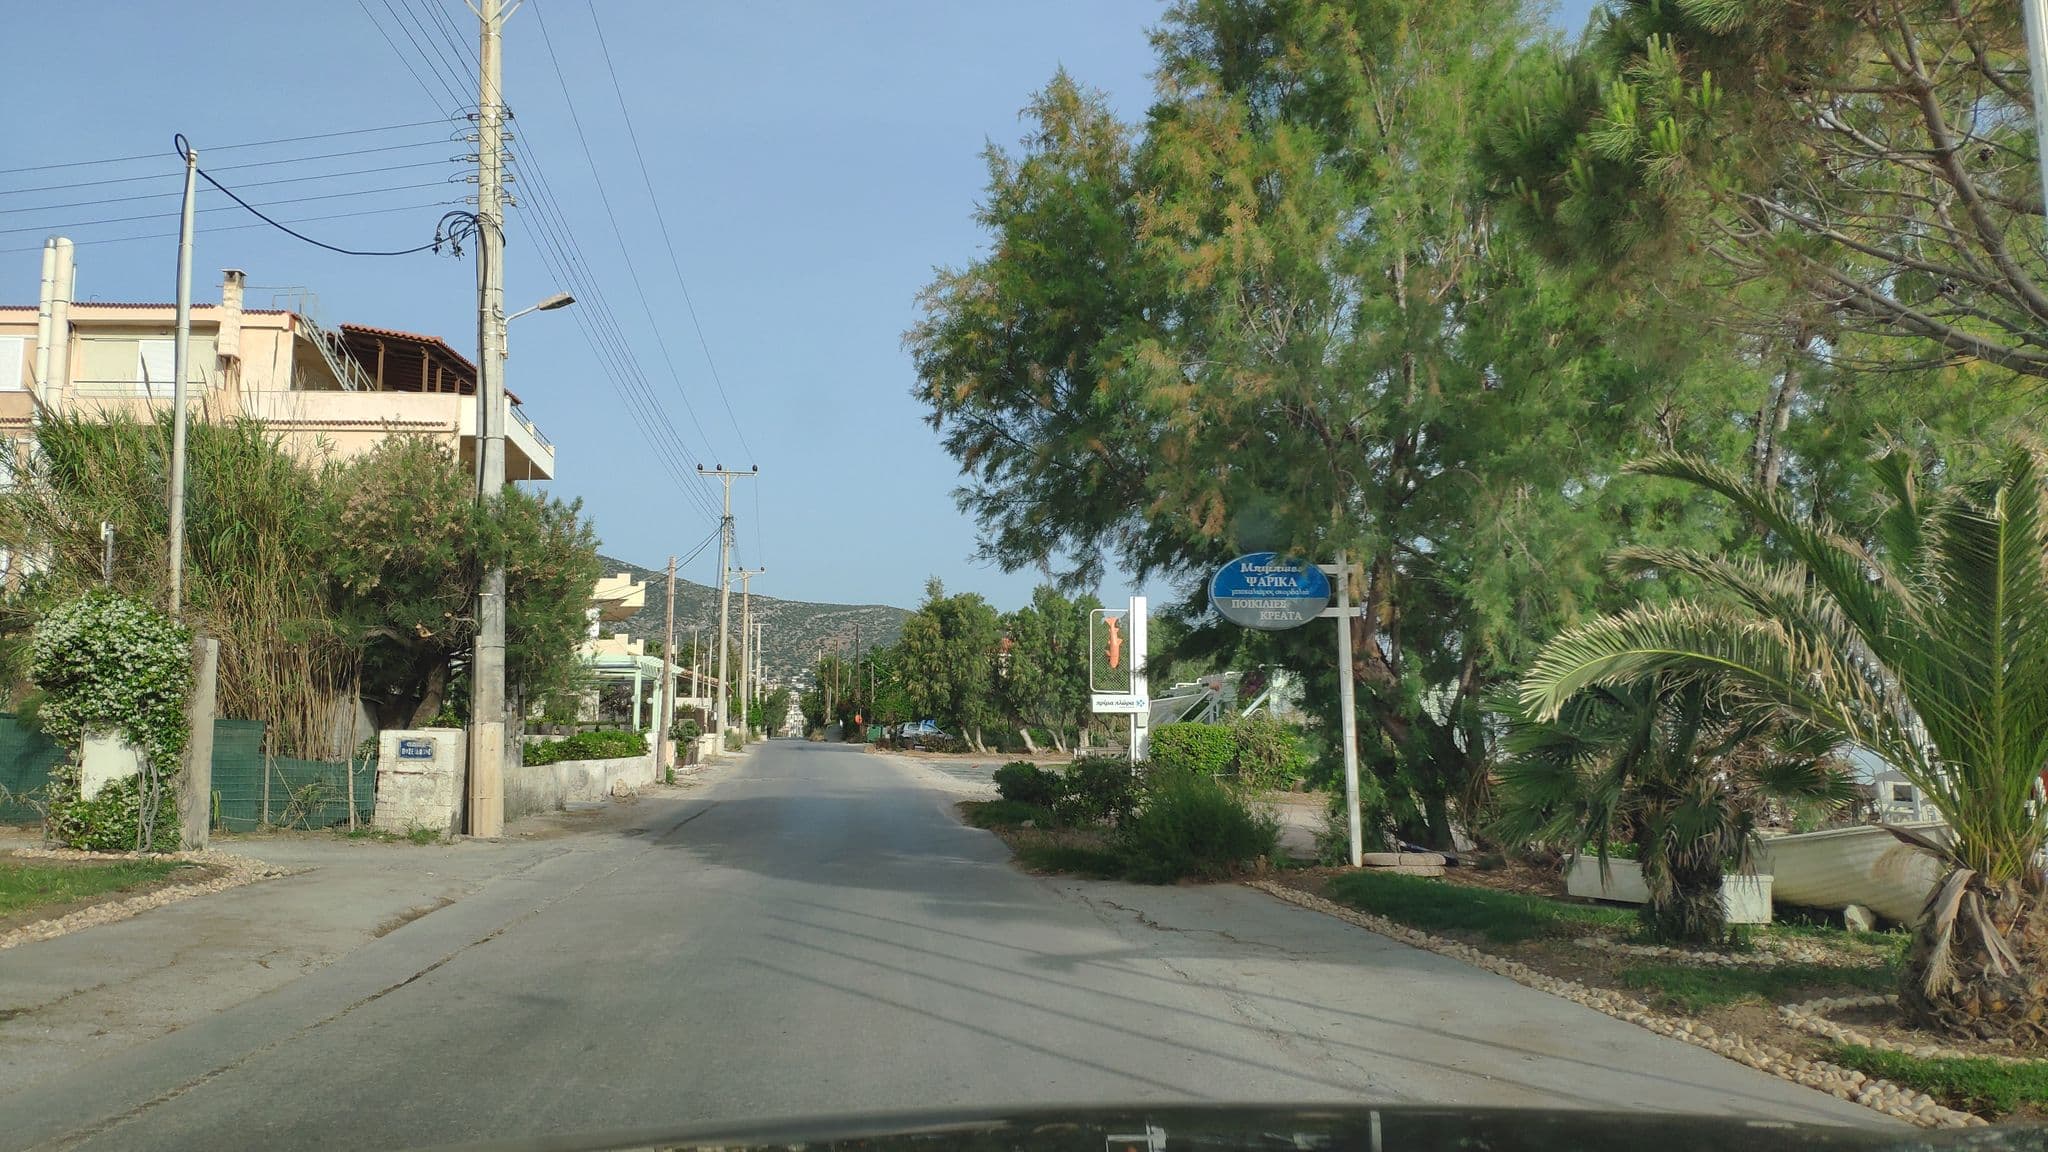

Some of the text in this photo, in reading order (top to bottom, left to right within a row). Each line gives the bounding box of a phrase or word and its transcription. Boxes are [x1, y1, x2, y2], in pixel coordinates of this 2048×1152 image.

[1246, 576, 1298, 587] ΨΑΡΙΚΑ
[1231, 599, 1287, 608] ΠΟΙΚΙΛΙΕΣ
[1260, 611, 1303, 620] ΚΡΕΑΤΑ
